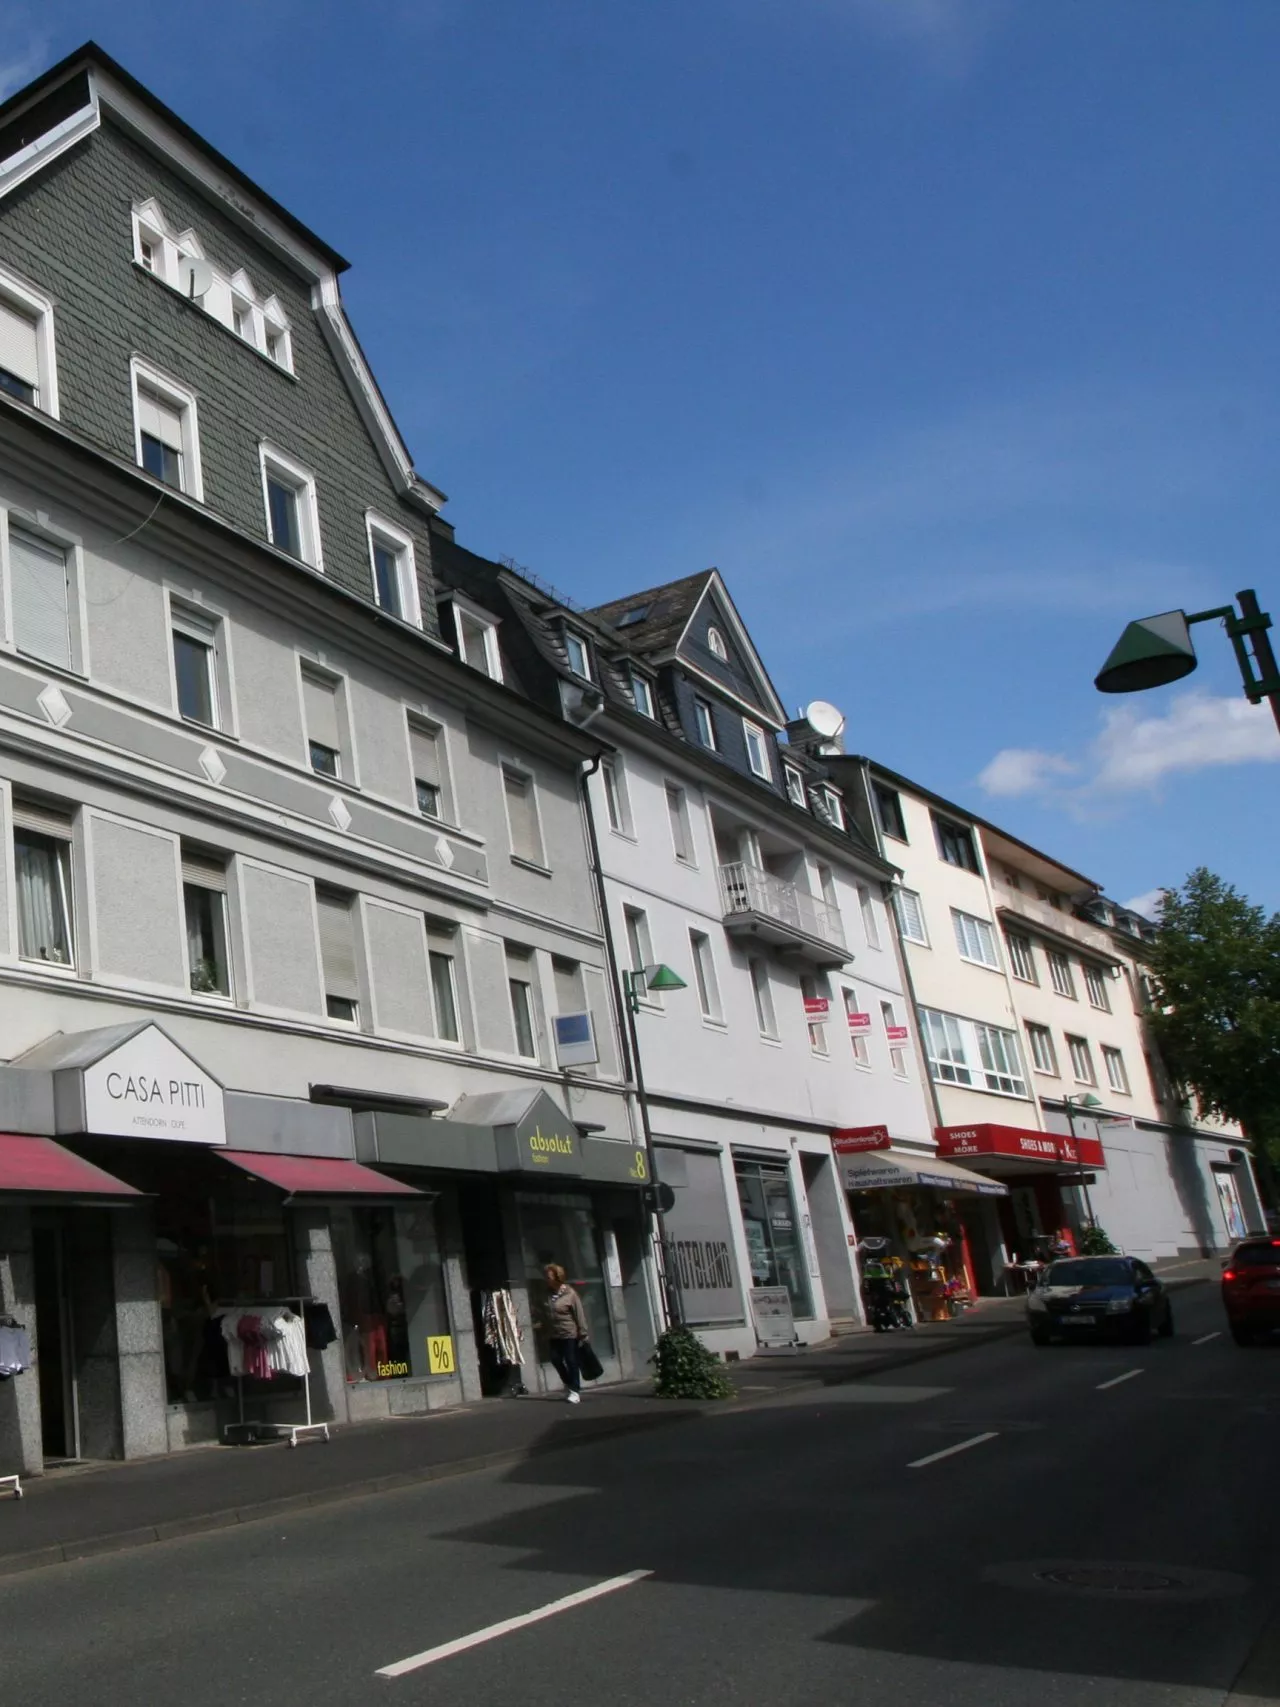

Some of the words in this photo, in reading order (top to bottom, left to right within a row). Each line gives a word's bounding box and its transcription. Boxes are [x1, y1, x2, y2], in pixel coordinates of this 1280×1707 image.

[106, 1072, 165, 1104] CASA
[169, 1080, 205, 1109] PITTI
[529, 1125, 573, 1154] absolut
[949, 1130, 978, 1140] SHOES
[953, 1145, 979, 1154] MORE
[377, 1360, 408, 1377] fashion
